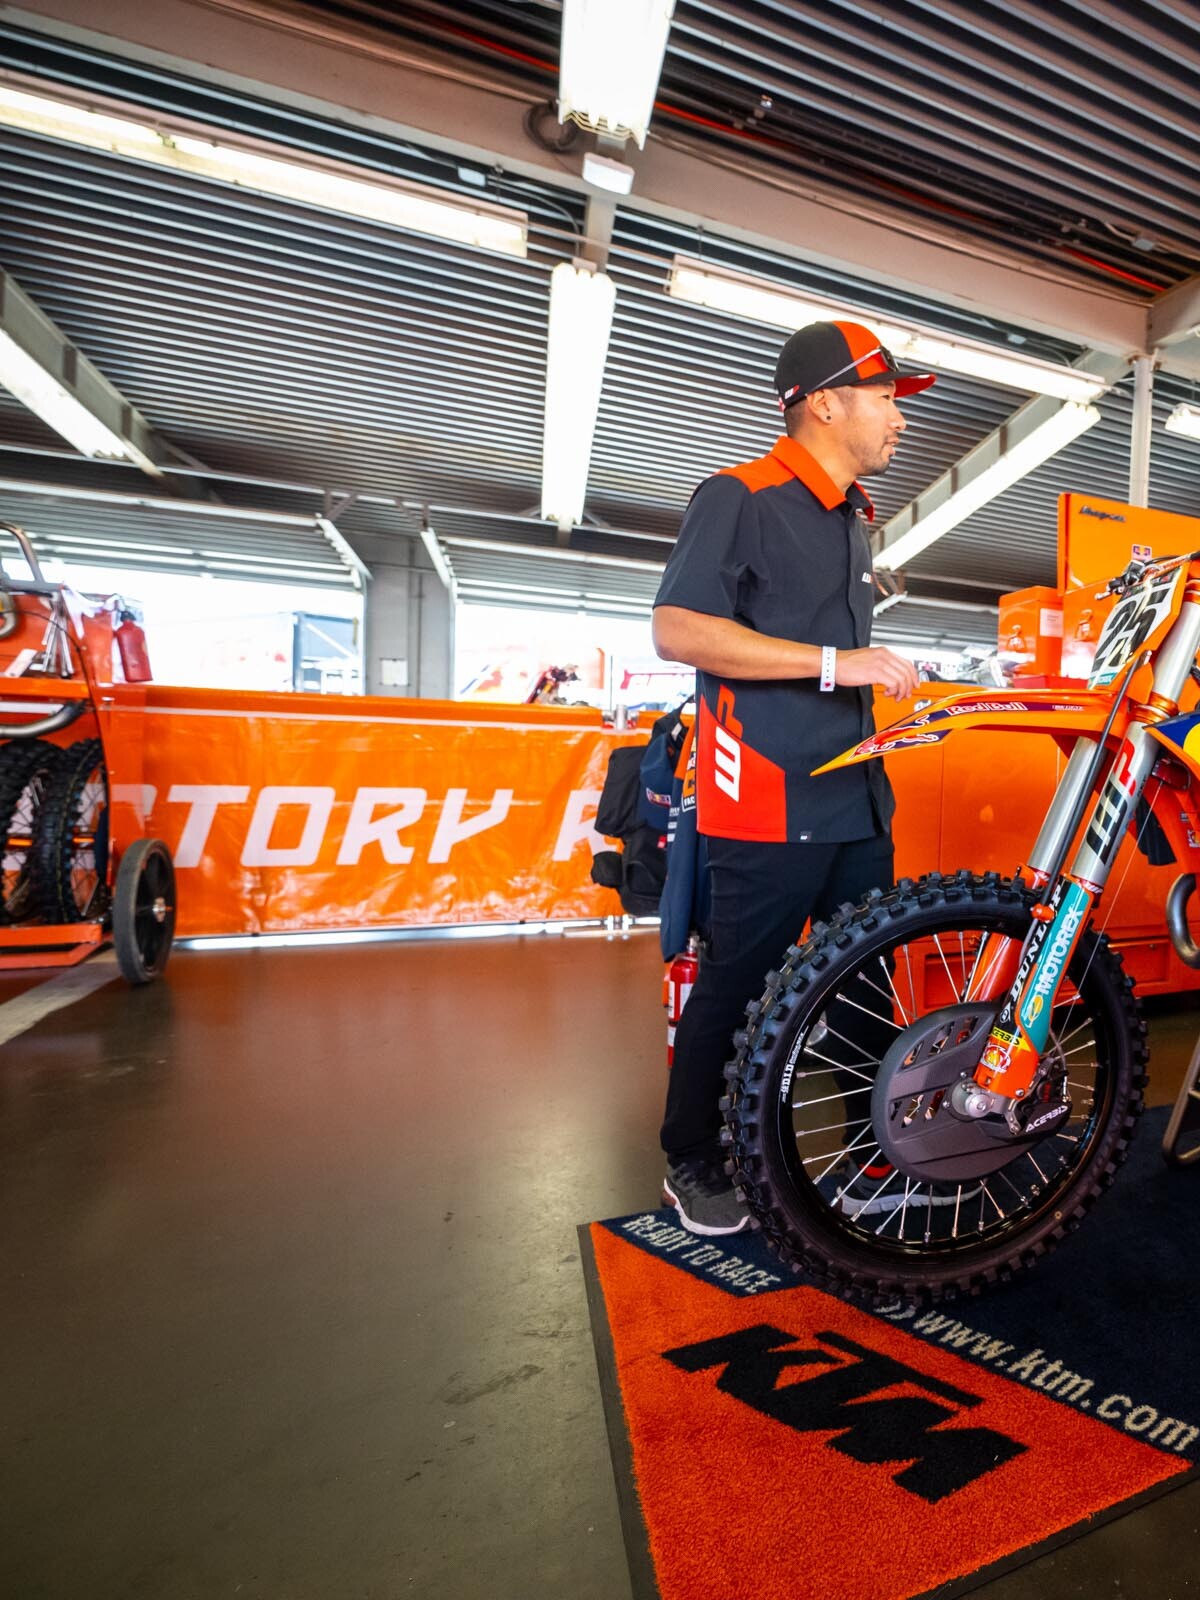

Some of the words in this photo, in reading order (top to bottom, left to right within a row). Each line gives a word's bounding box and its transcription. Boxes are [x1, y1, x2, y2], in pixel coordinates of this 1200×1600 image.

[1091, 586, 1172, 673] 25
[946, 702, 986, 716] Red
[985, 701, 1028, 712] Bull
[1010, 884, 1062, 1002] DUNLP
[1034, 904, 1084, 995] MOTOREX
[1025, 1105, 1068, 1133] ACERBIS
[621, 1214, 700, 1252] READY
[681, 1244, 725, 1266] TO
[705, 1255, 781, 1294] RACE
[660, 1323, 1031, 1504] KTM
[910, 1310, 1200, 1452] www.ktm.com
